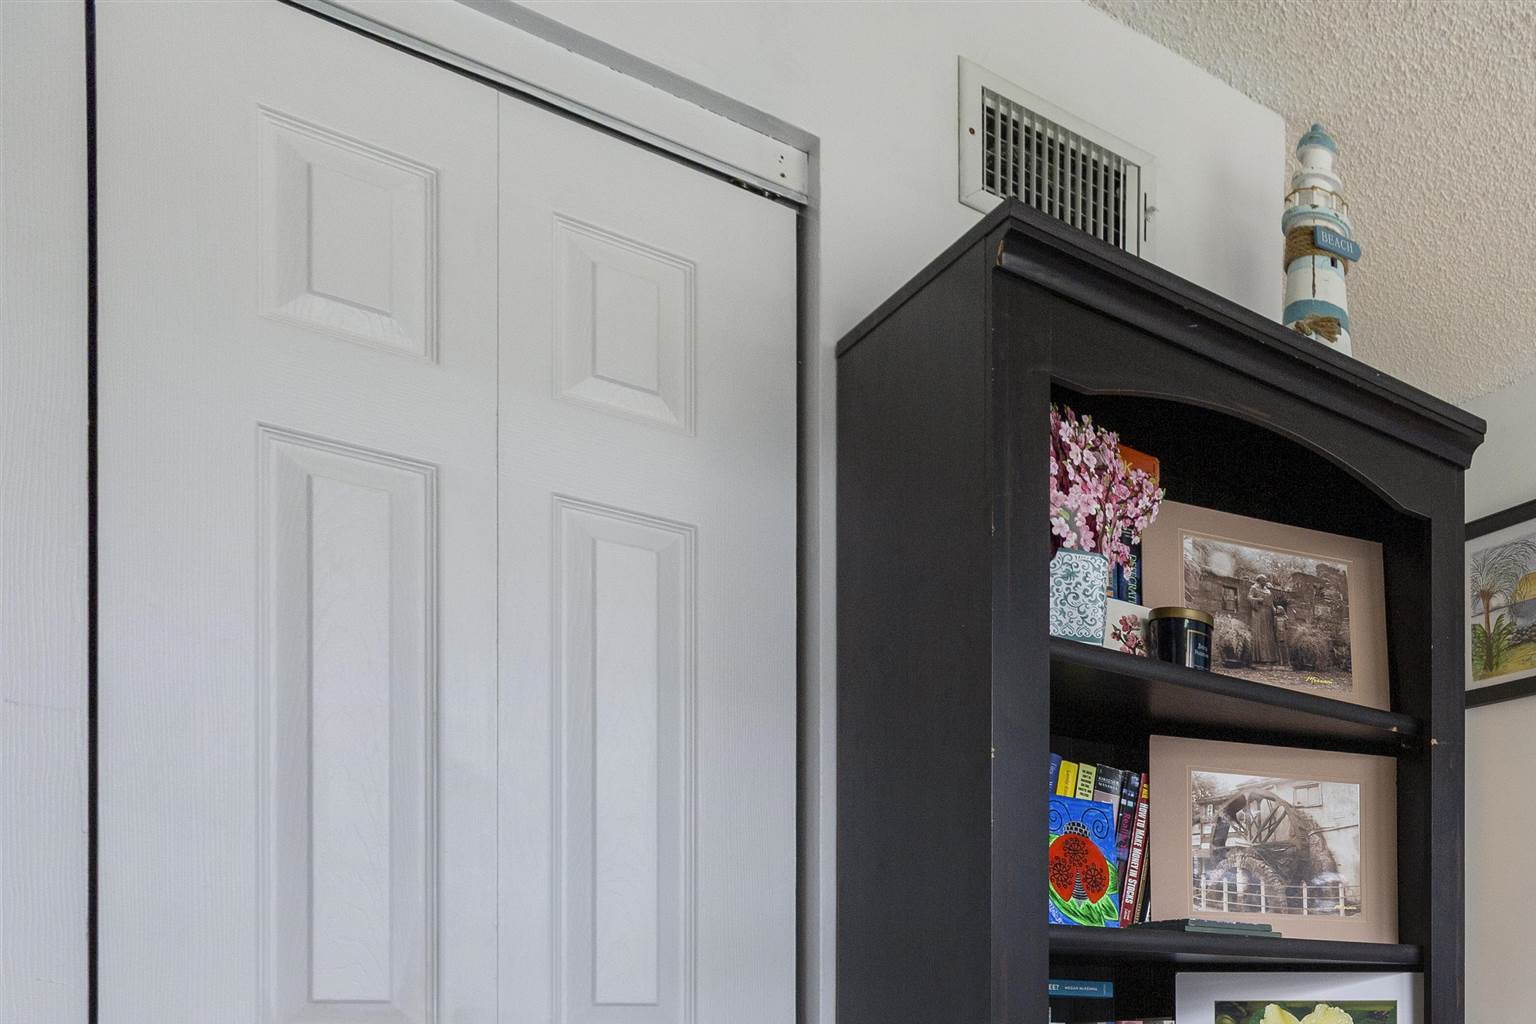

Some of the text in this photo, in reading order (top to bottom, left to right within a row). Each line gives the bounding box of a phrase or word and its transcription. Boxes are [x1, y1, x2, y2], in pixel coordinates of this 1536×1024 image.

[1321, 231, 1353, 253] BEACH
[1125, 802, 1149, 905] HOW TO MAKE MONEY IN STOCKS
